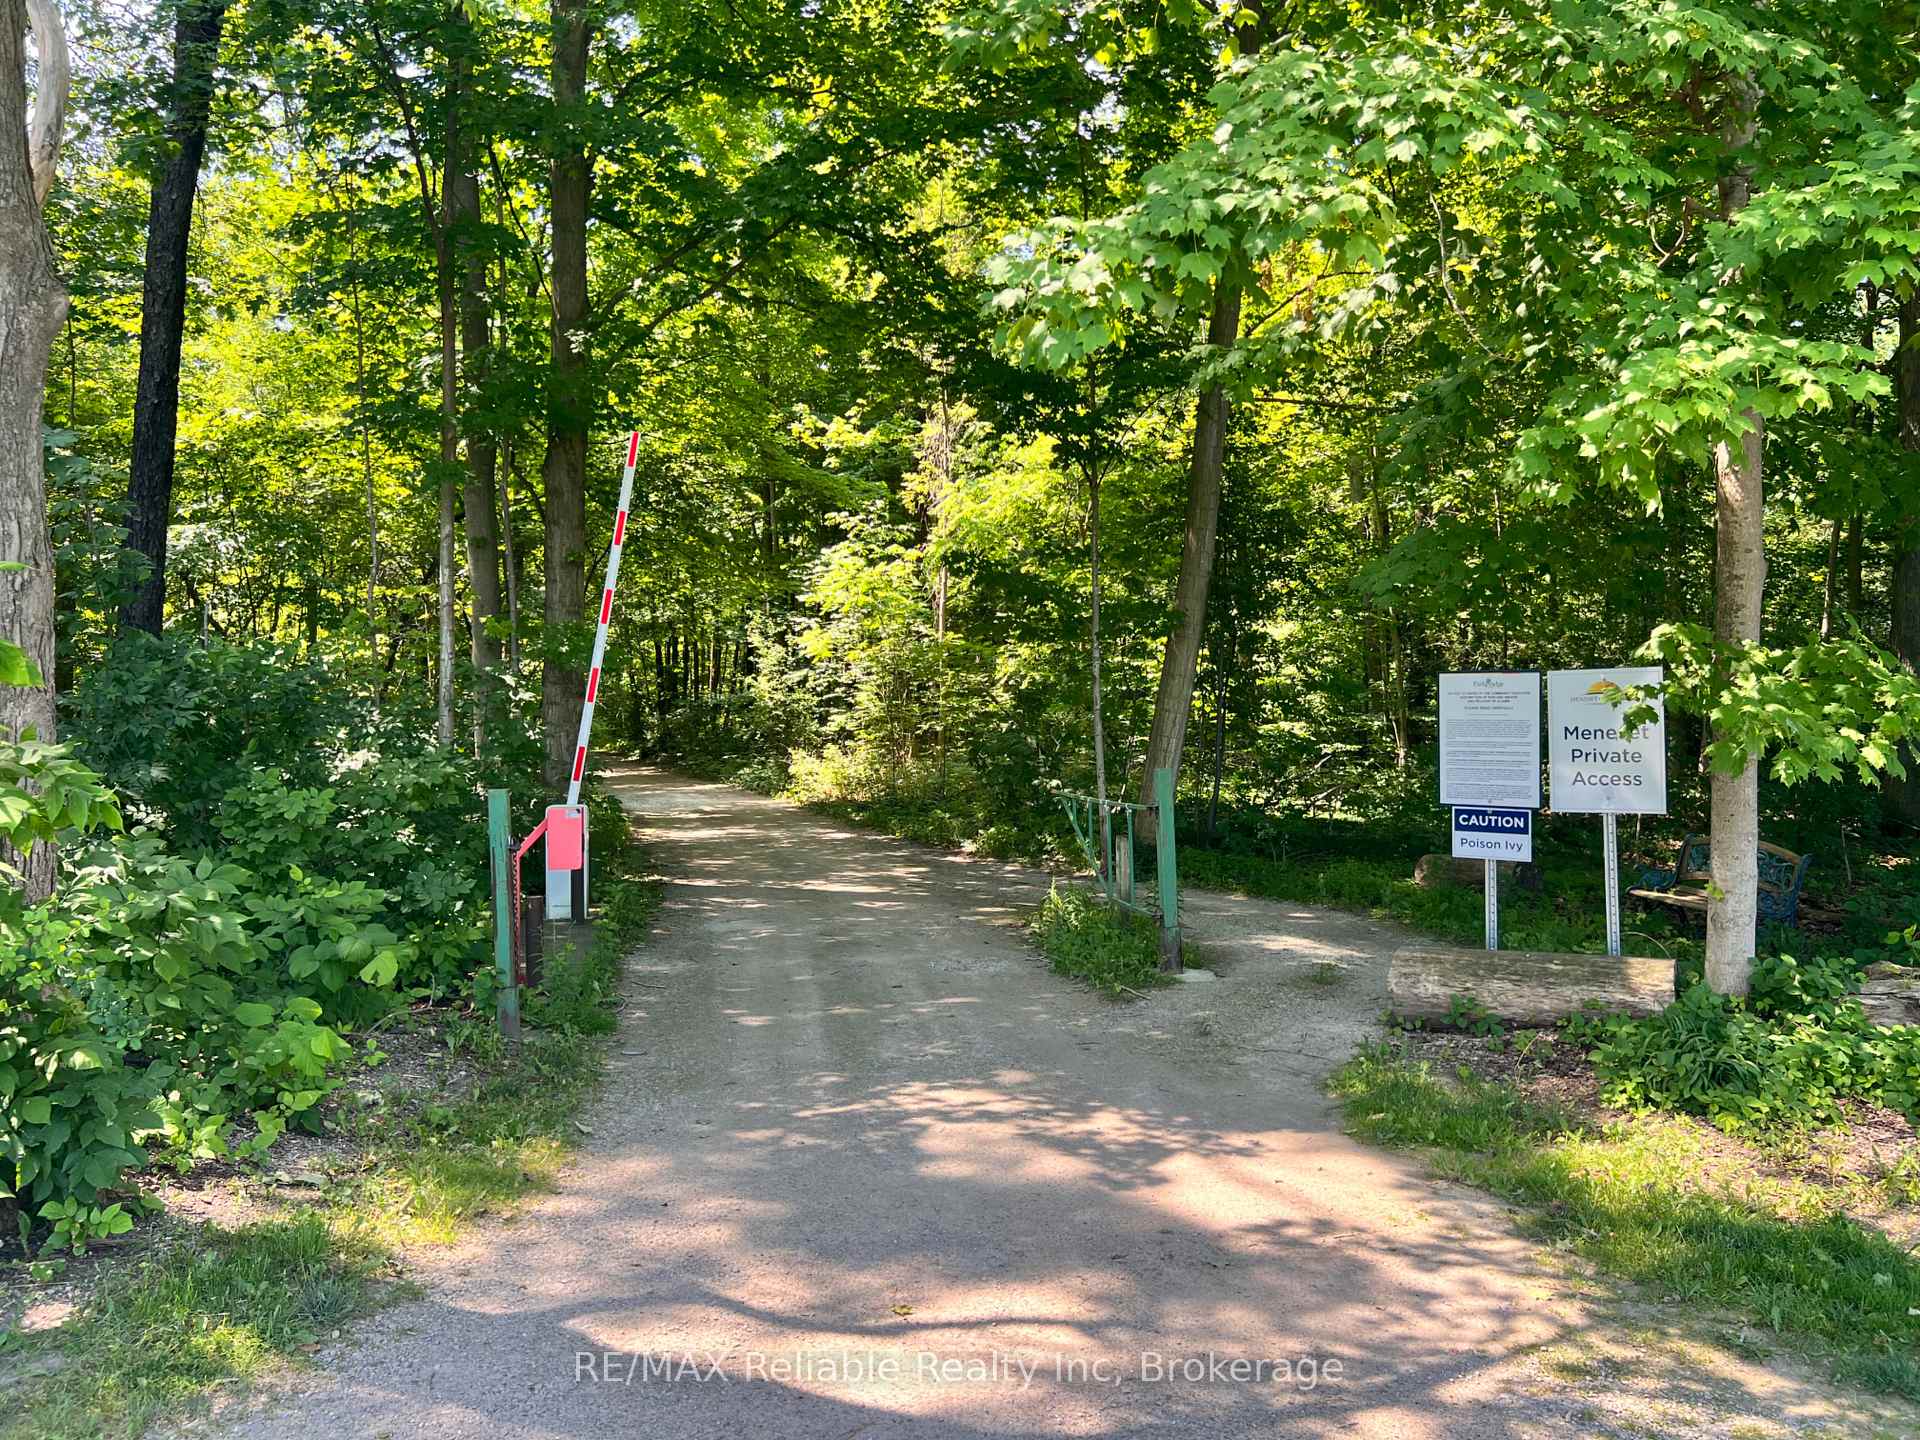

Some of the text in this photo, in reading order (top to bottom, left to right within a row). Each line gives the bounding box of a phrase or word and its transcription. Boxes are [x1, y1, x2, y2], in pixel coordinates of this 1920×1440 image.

[1563, 726, 1649, 740] Meneet
[1571, 748, 1642, 763] Private
[1572, 770, 1642, 786] Access
[1458, 813, 1525, 829] CAUTION
[1460, 837, 1524, 852] Poison Ivy
